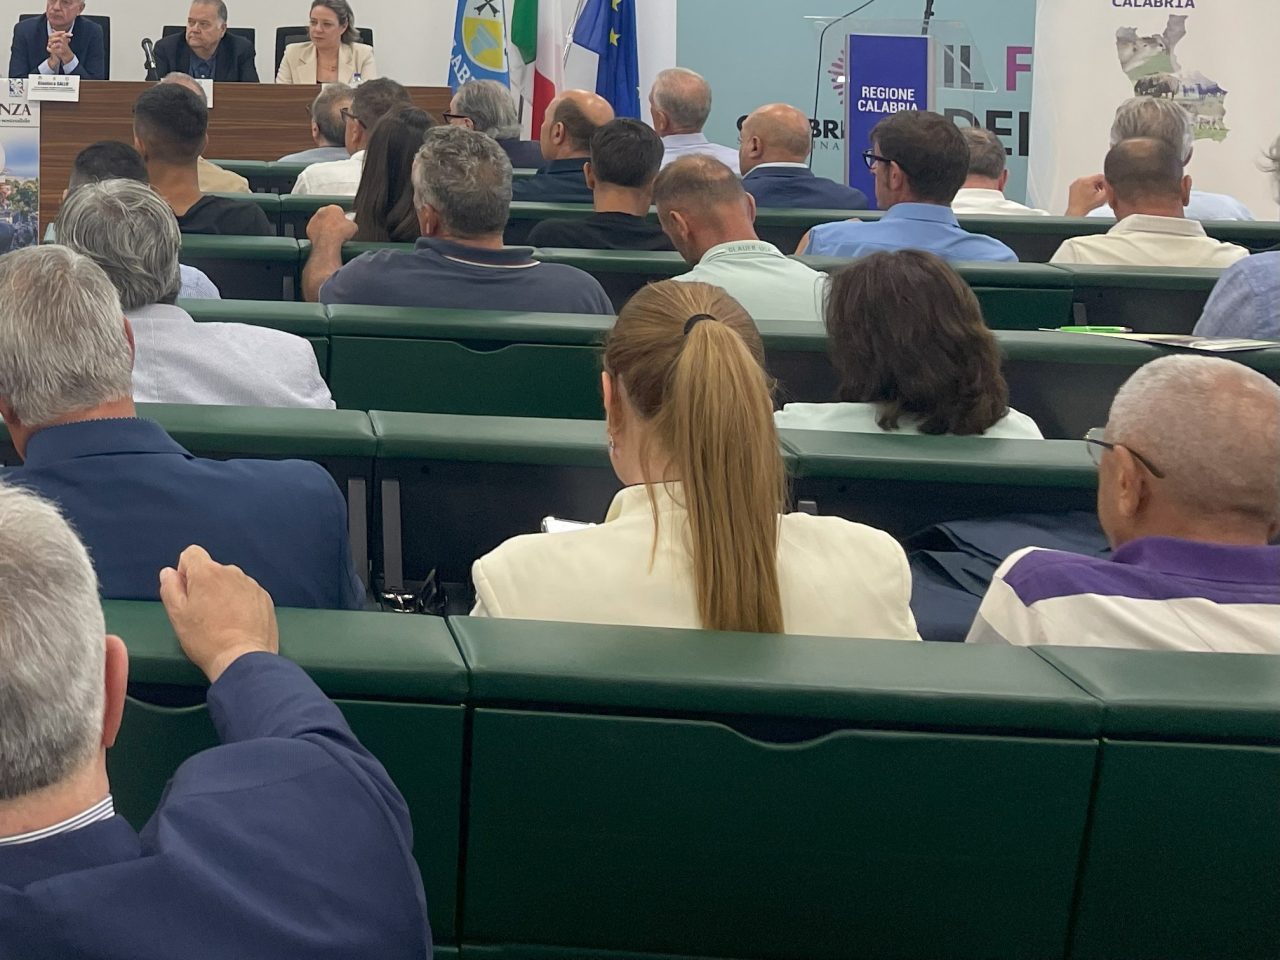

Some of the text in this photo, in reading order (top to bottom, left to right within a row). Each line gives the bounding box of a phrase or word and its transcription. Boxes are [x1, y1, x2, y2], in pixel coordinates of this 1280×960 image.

[944, 45, 984, 90] IL
[861, 86, 915, 101] REGIONE
[857, 99, 919, 114] CALABRIA
